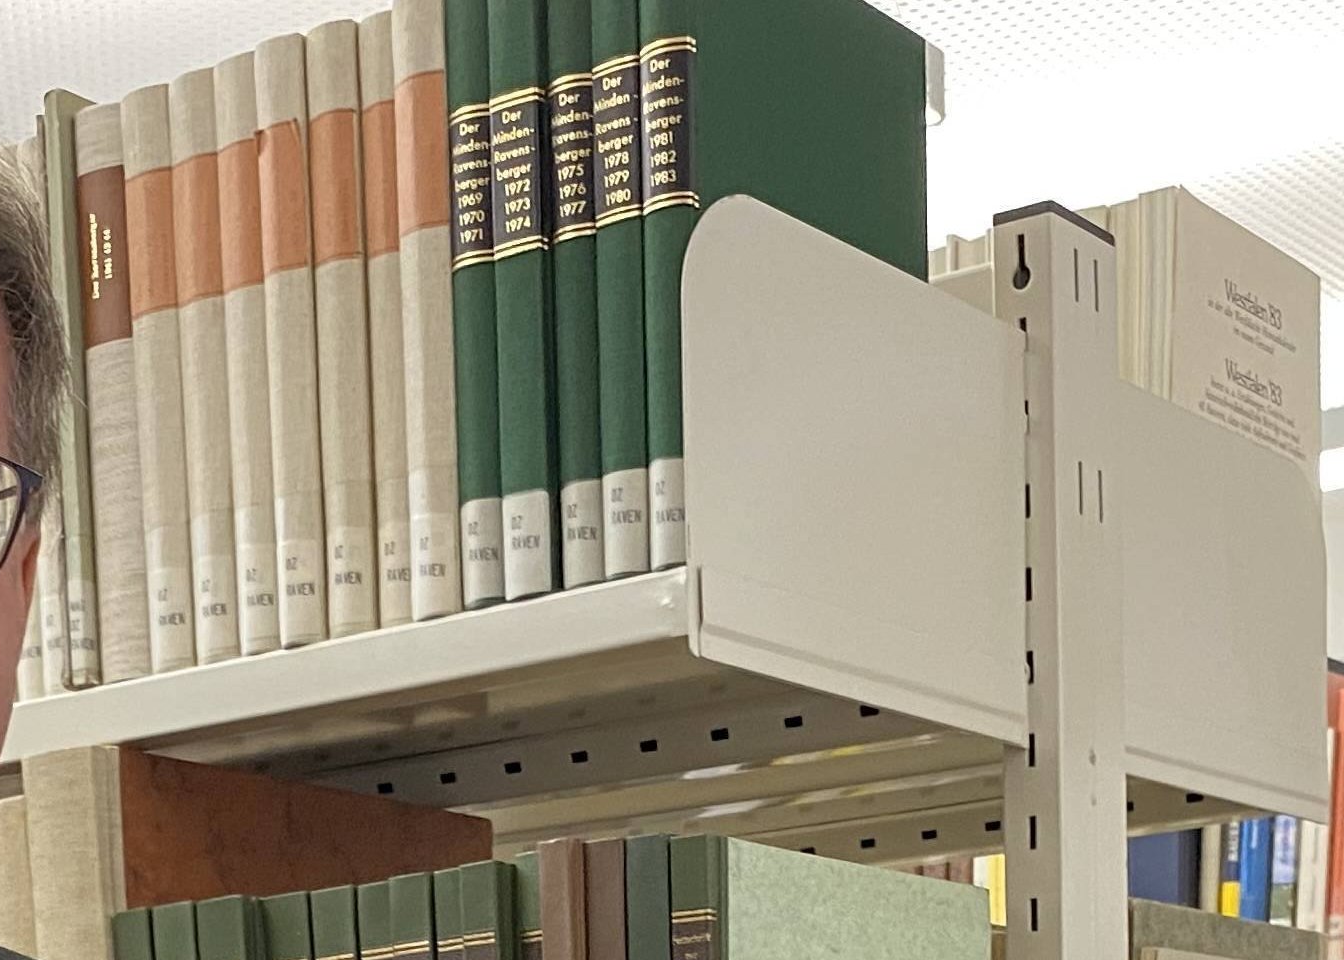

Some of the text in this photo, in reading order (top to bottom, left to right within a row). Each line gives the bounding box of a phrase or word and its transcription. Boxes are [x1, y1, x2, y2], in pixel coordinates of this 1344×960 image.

[649, 58, 671, 73] Der
[602, 76, 623, 91] Der
[558, 93, 581, 107] Der
[642, 95, 685, 115] Ravens-
[502, 110, 522, 124] Der
[645, 114, 682, 133] berger
[459, 122, 480, 136] Der
[492, 126, 535, 146] Minden-
[598, 134, 634, 154] berger
[649, 131, 674, 150] 1981
[494, 145, 536, 164] Ravens-
[555, 147, 591, 164] berger
[604, 151, 630, 170] 1978
[650, 150, 677, 168] 1982
[496, 163, 532, 182] berger
[558, 164, 585, 182] 1975
[604, 171, 630, 189] 1979
[650, 169, 677, 187] 1983
[455, 176, 490, 192] berger
[505, 179, 531, 197] 1972
[560, 182, 587, 200] 1976
[458, 192, 483, 209] 1969
[505, 197, 531, 215] 1973
[606, 188, 632, 207] 1980
[560, 200, 587, 218] 1977
[459, 210, 485, 227] 1970
[505, 215, 531, 234] 1974
[460, 228, 484, 244] 1971
[611, 509, 642, 525] RAVEN
[512, 535, 540, 549] RAVEN
